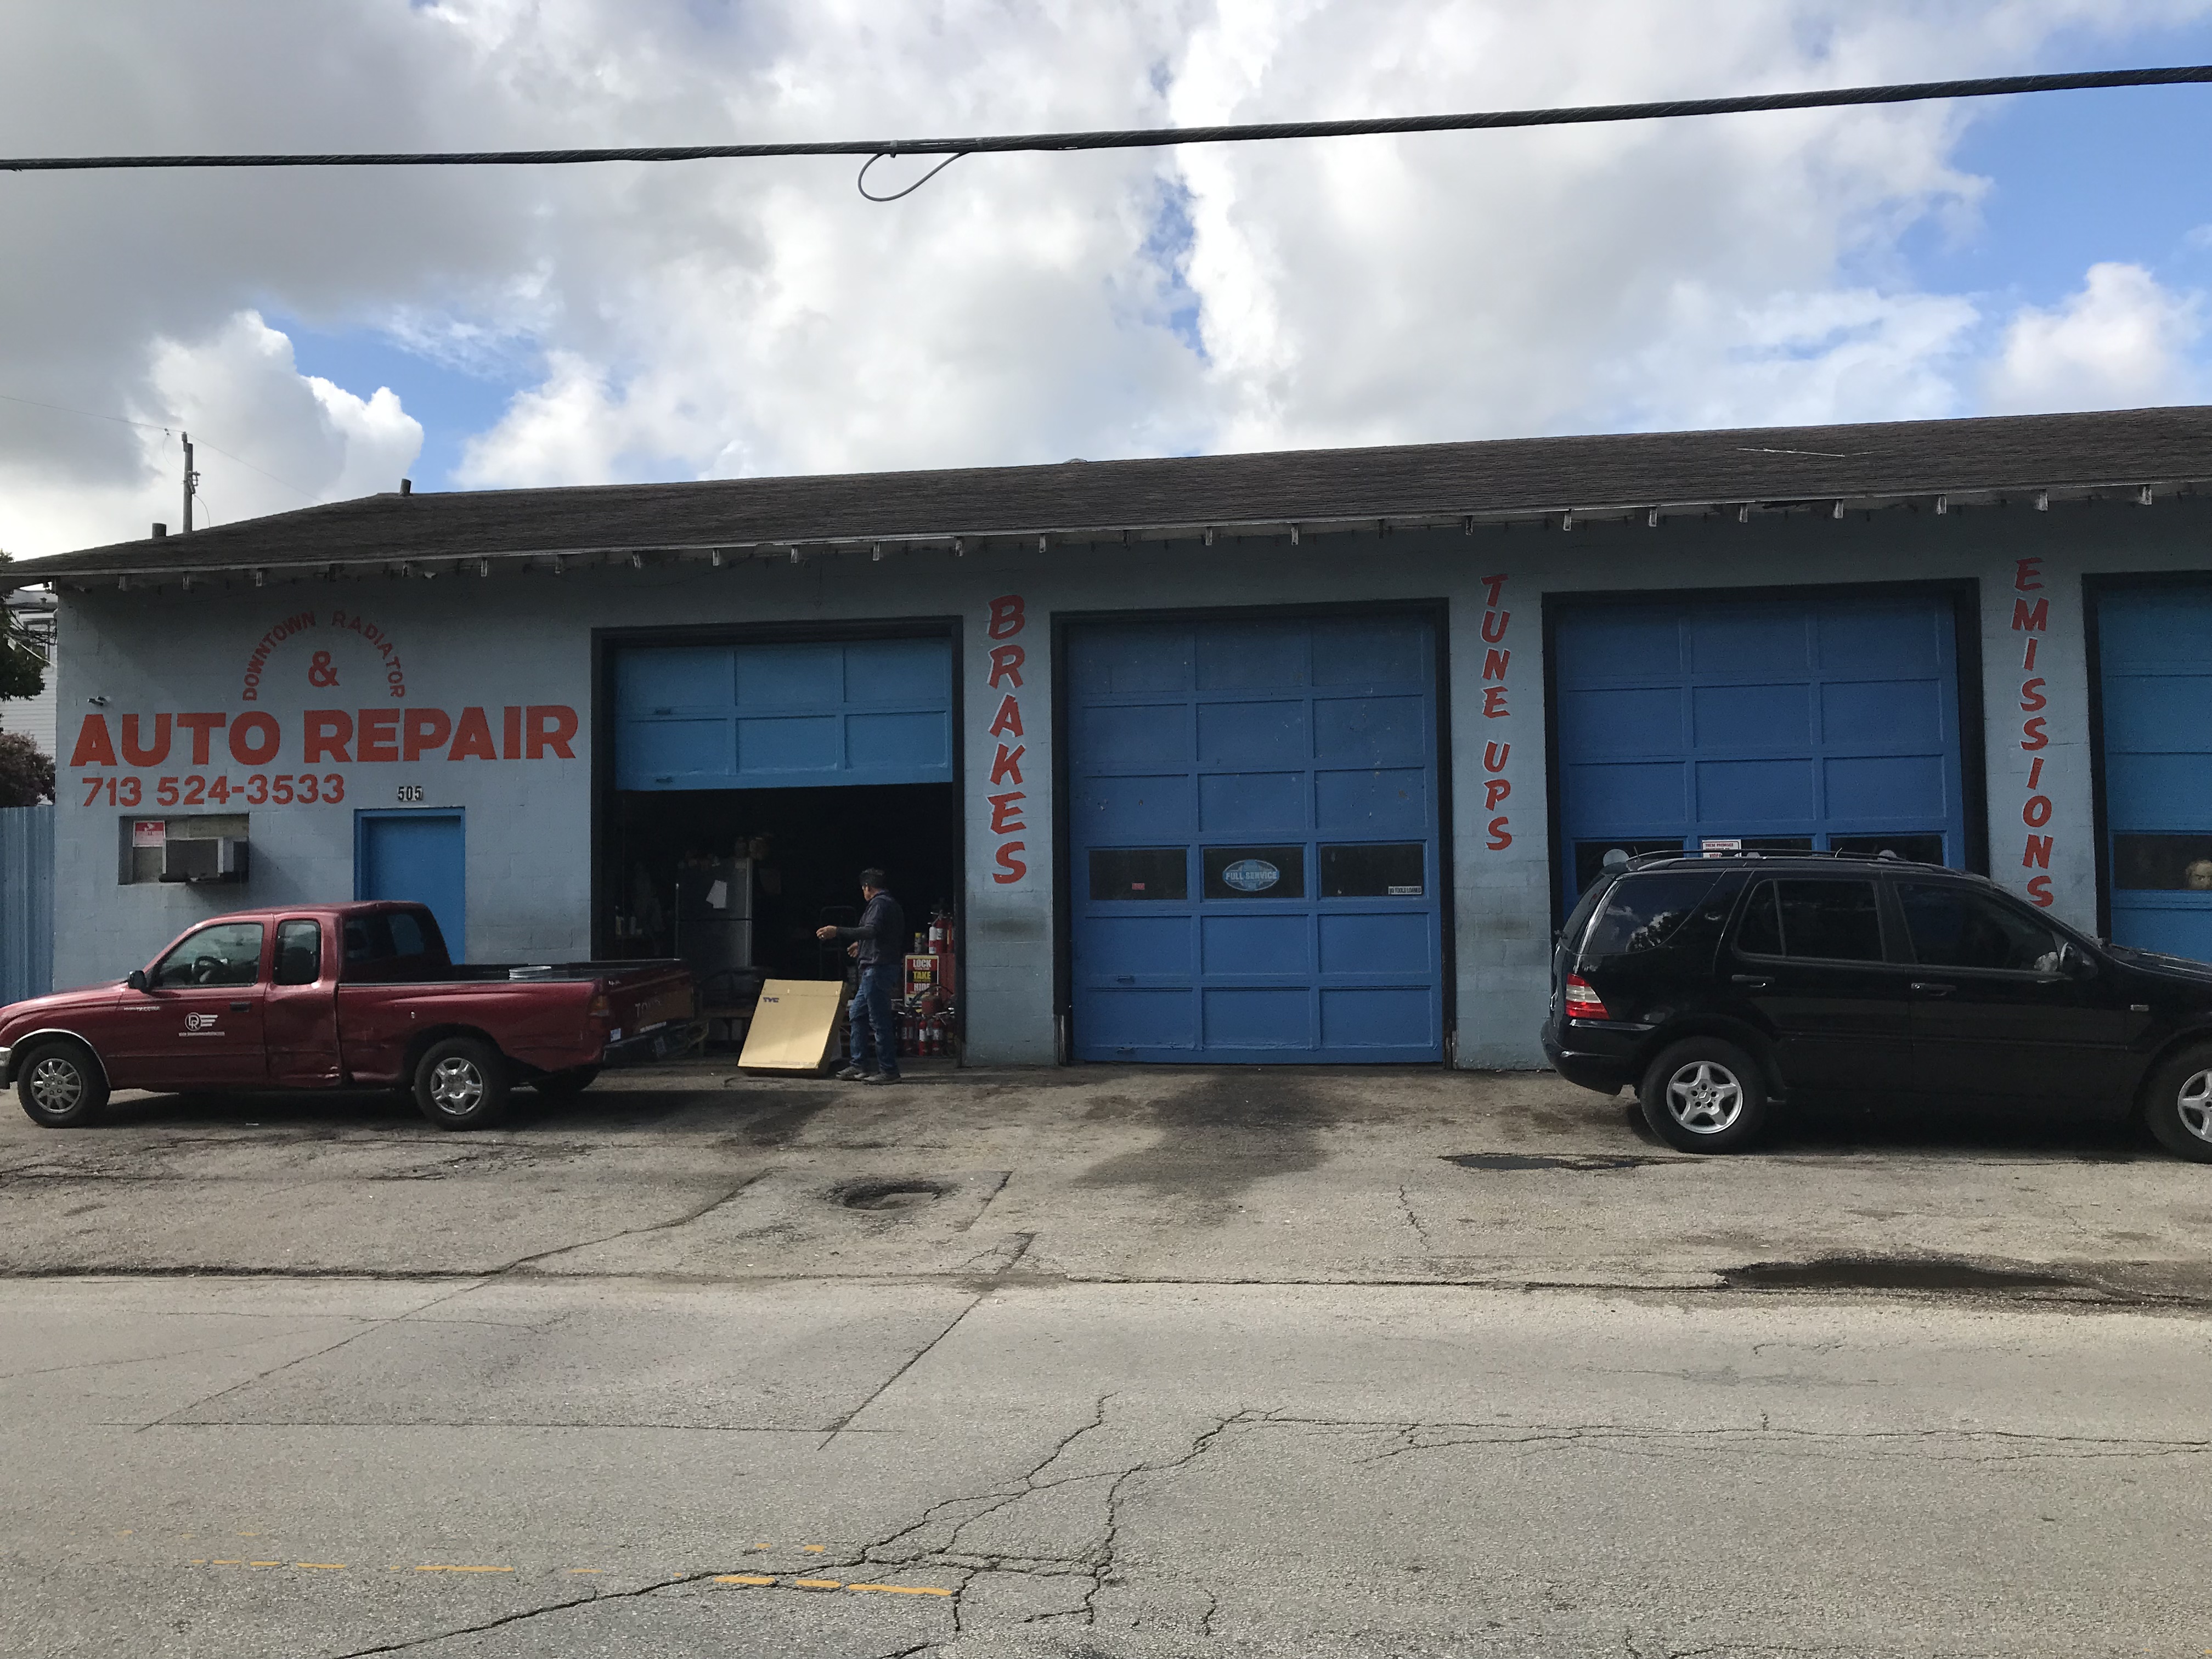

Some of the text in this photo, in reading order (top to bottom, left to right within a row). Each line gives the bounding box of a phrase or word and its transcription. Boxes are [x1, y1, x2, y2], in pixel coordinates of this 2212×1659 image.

[242, 610, 405, 701] DOWNTOWN RADIATOR
[308, 650, 340, 687] &
[1481, 573, 1513, 851] TUNE UPS
[70, 706, 579, 767] AUTO REPAIR
[987, 594, 1027, 884] BRAKES
[2011, 557, 2054, 907] EMISSIONS
[82, 774, 345, 808] 713 524-3533
[398, 786, 423, 801] 505
[1226, 871, 1277, 881] FULL SERVICE
[912, 959, 932, 968] LOCK
[913, 971, 931, 979] TAKE
